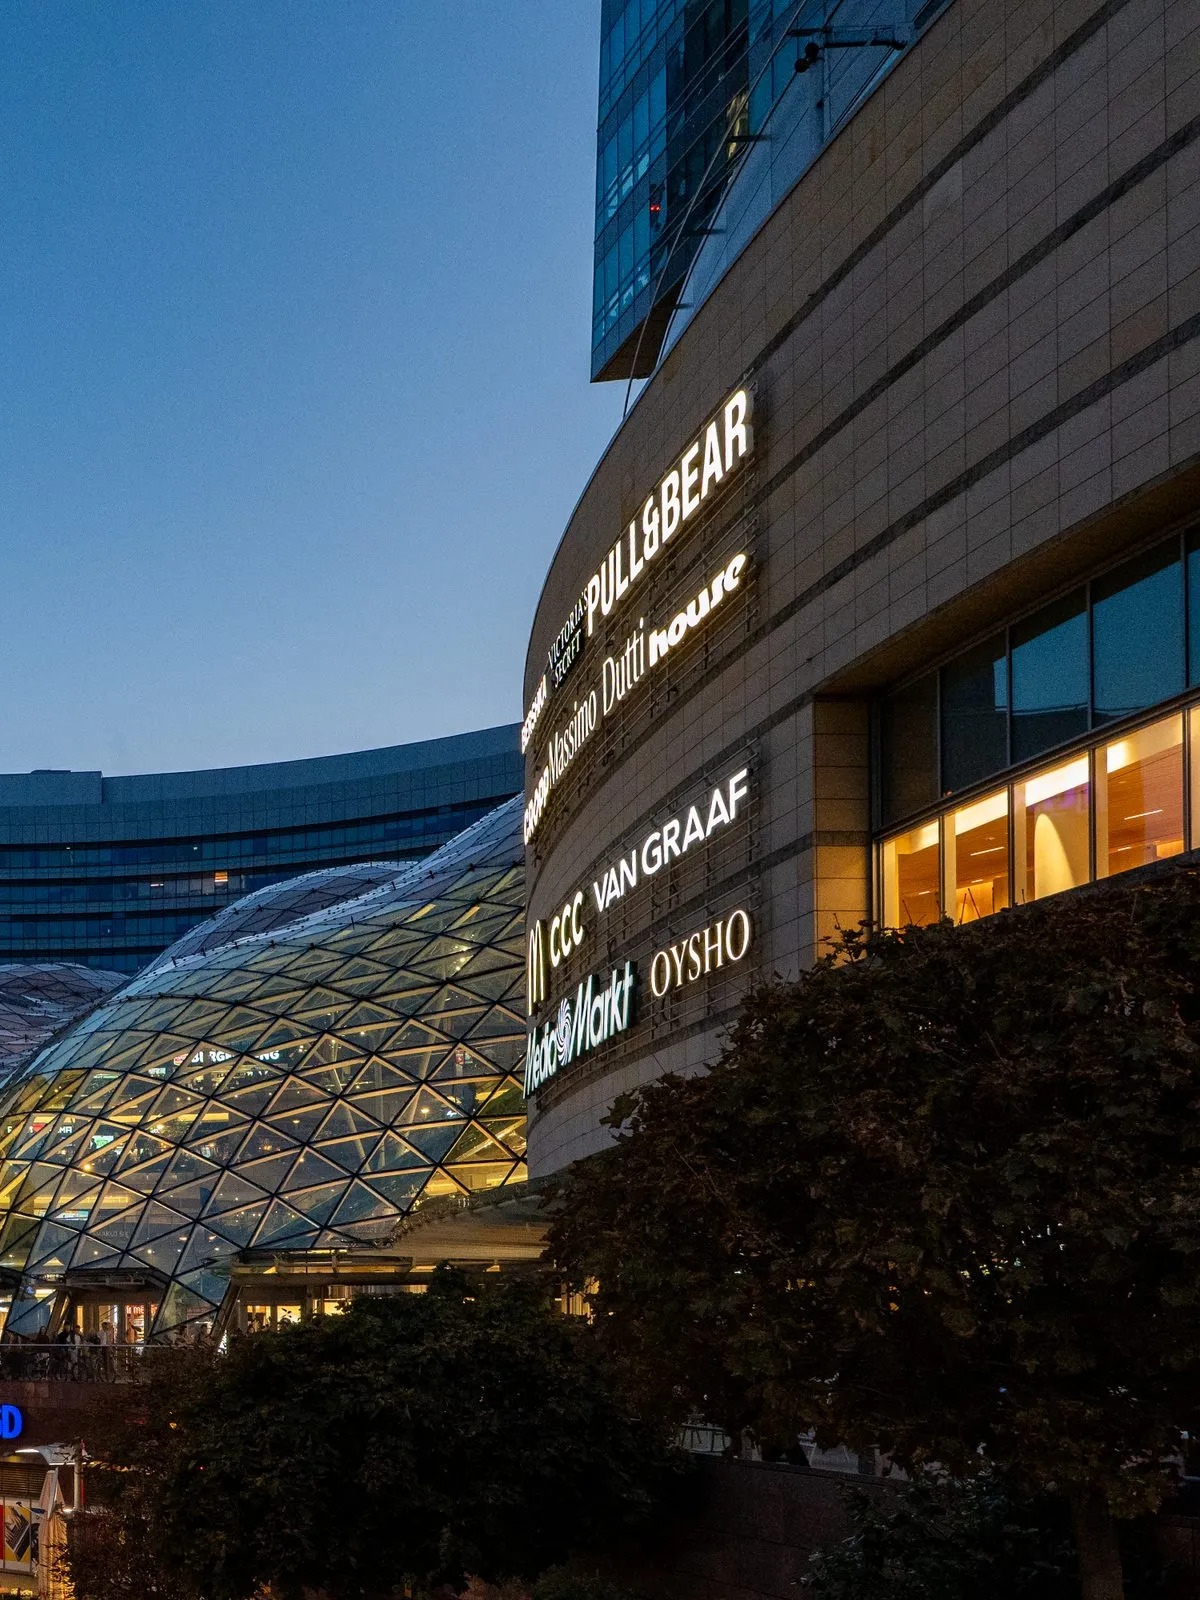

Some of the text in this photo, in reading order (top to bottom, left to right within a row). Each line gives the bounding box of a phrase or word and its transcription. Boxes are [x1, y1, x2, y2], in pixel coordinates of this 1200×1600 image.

[587, 390, 748, 637] PULL&BEAR
[549, 617, 645, 789] Massimo Dutti
[593, 768, 749, 912] VAN GRAAF
[650, 909, 750, 997] OYSHO
